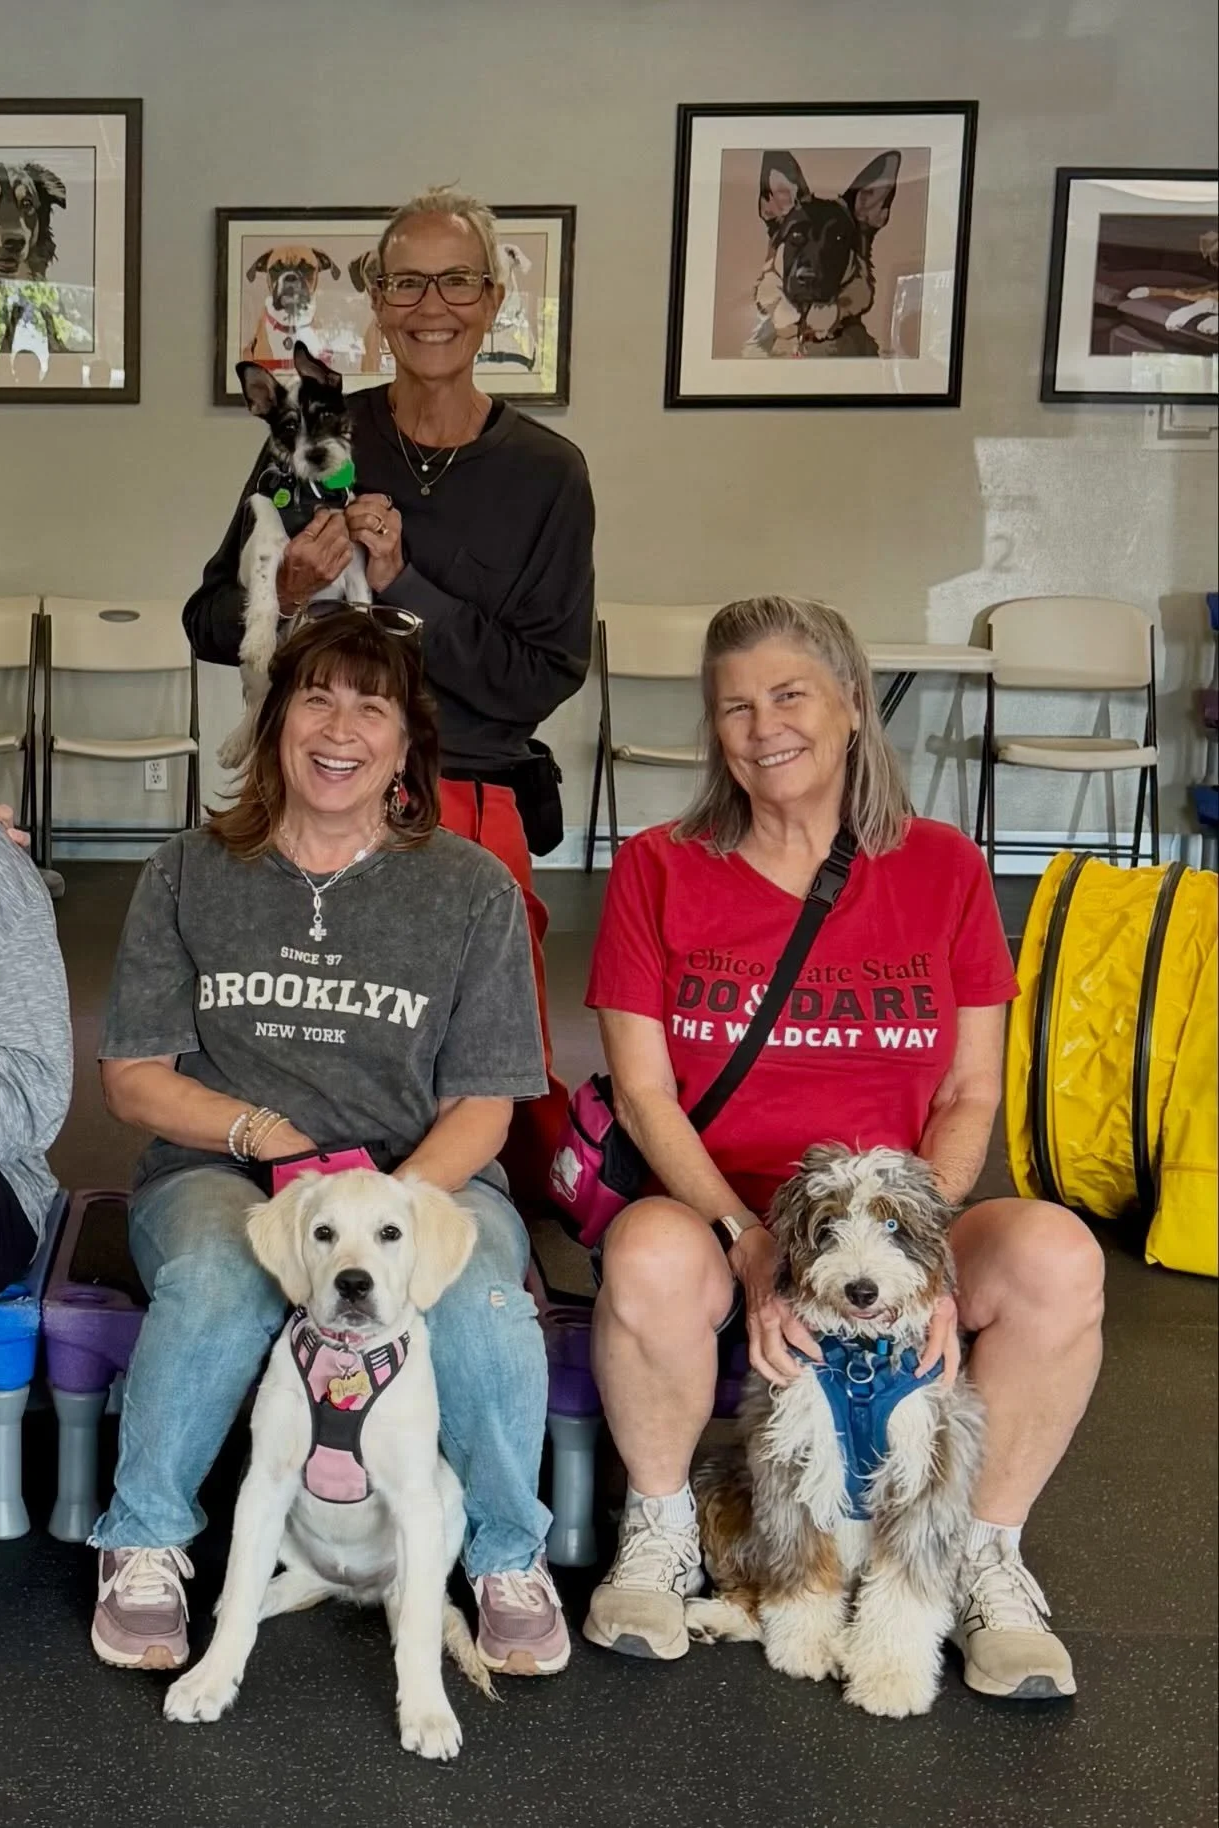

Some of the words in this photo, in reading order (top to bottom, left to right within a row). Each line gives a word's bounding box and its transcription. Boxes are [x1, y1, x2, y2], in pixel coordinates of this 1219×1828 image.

[280, 946, 320, 965] SINCE
[688, 948, 766, 977] Chico
[777, 959, 852, 983] ate
[862, 952, 934, 982] Staff
[199, 971, 429, 1029] BROOKLYN
[677, 974, 741, 1013] DO
[790, 985, 938, 1021] DARE
[255, 1021, 296, 1040] NEW
[302, 1027, 346, 1044] YORK
[672, 1014, 715, 1041] THE
[725, 1021, 863, 1048] WLDCAT
[875, 1027, 938, 1049] WAY
